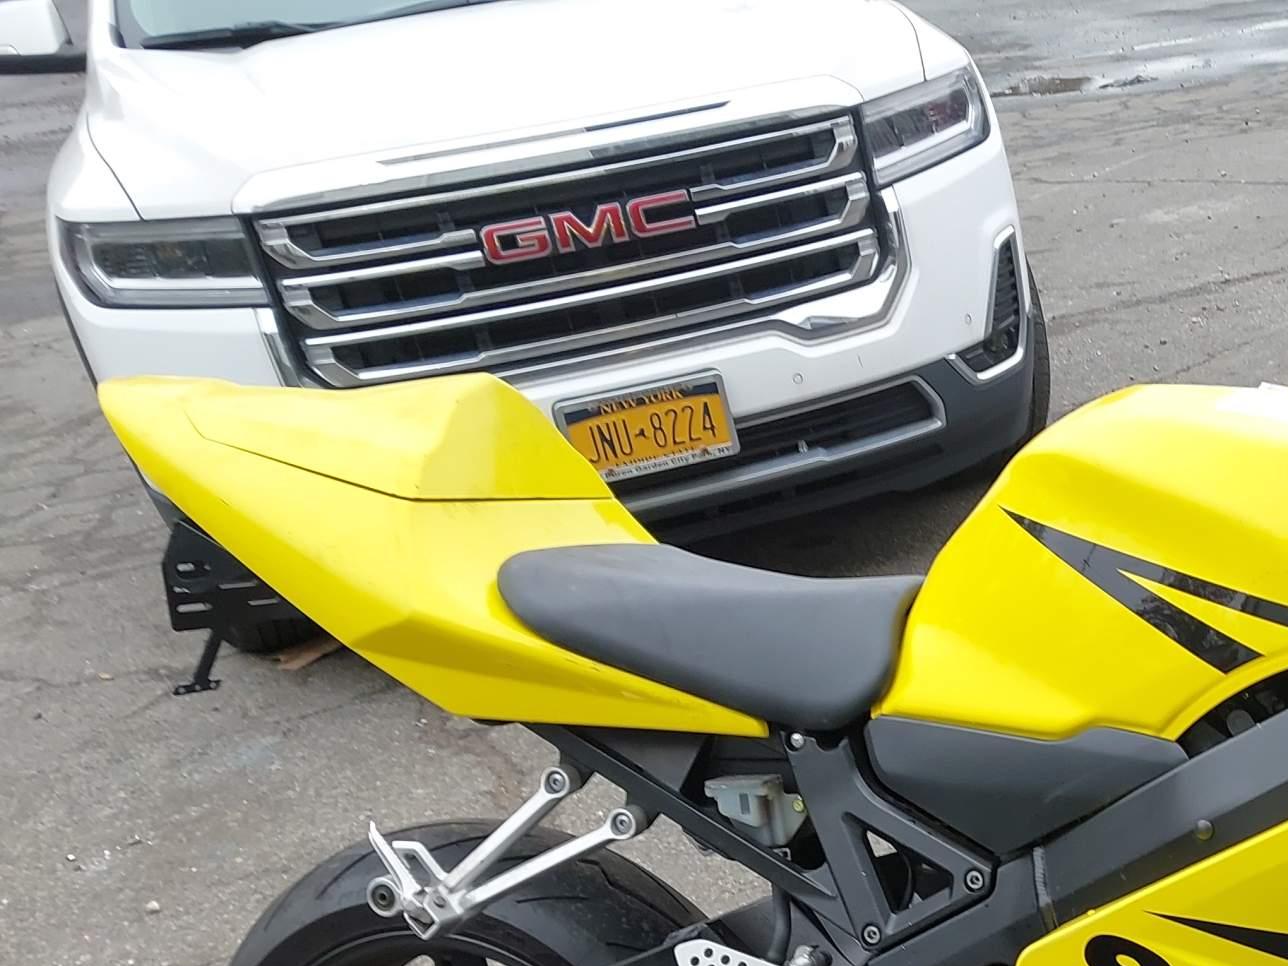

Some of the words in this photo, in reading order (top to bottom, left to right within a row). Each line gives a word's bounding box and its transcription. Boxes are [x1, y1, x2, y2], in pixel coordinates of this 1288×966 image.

[481, 189, 696, 266] GMC
[600, 398, 640, 416] NEW
[643, 388, 684, 405] YORK
